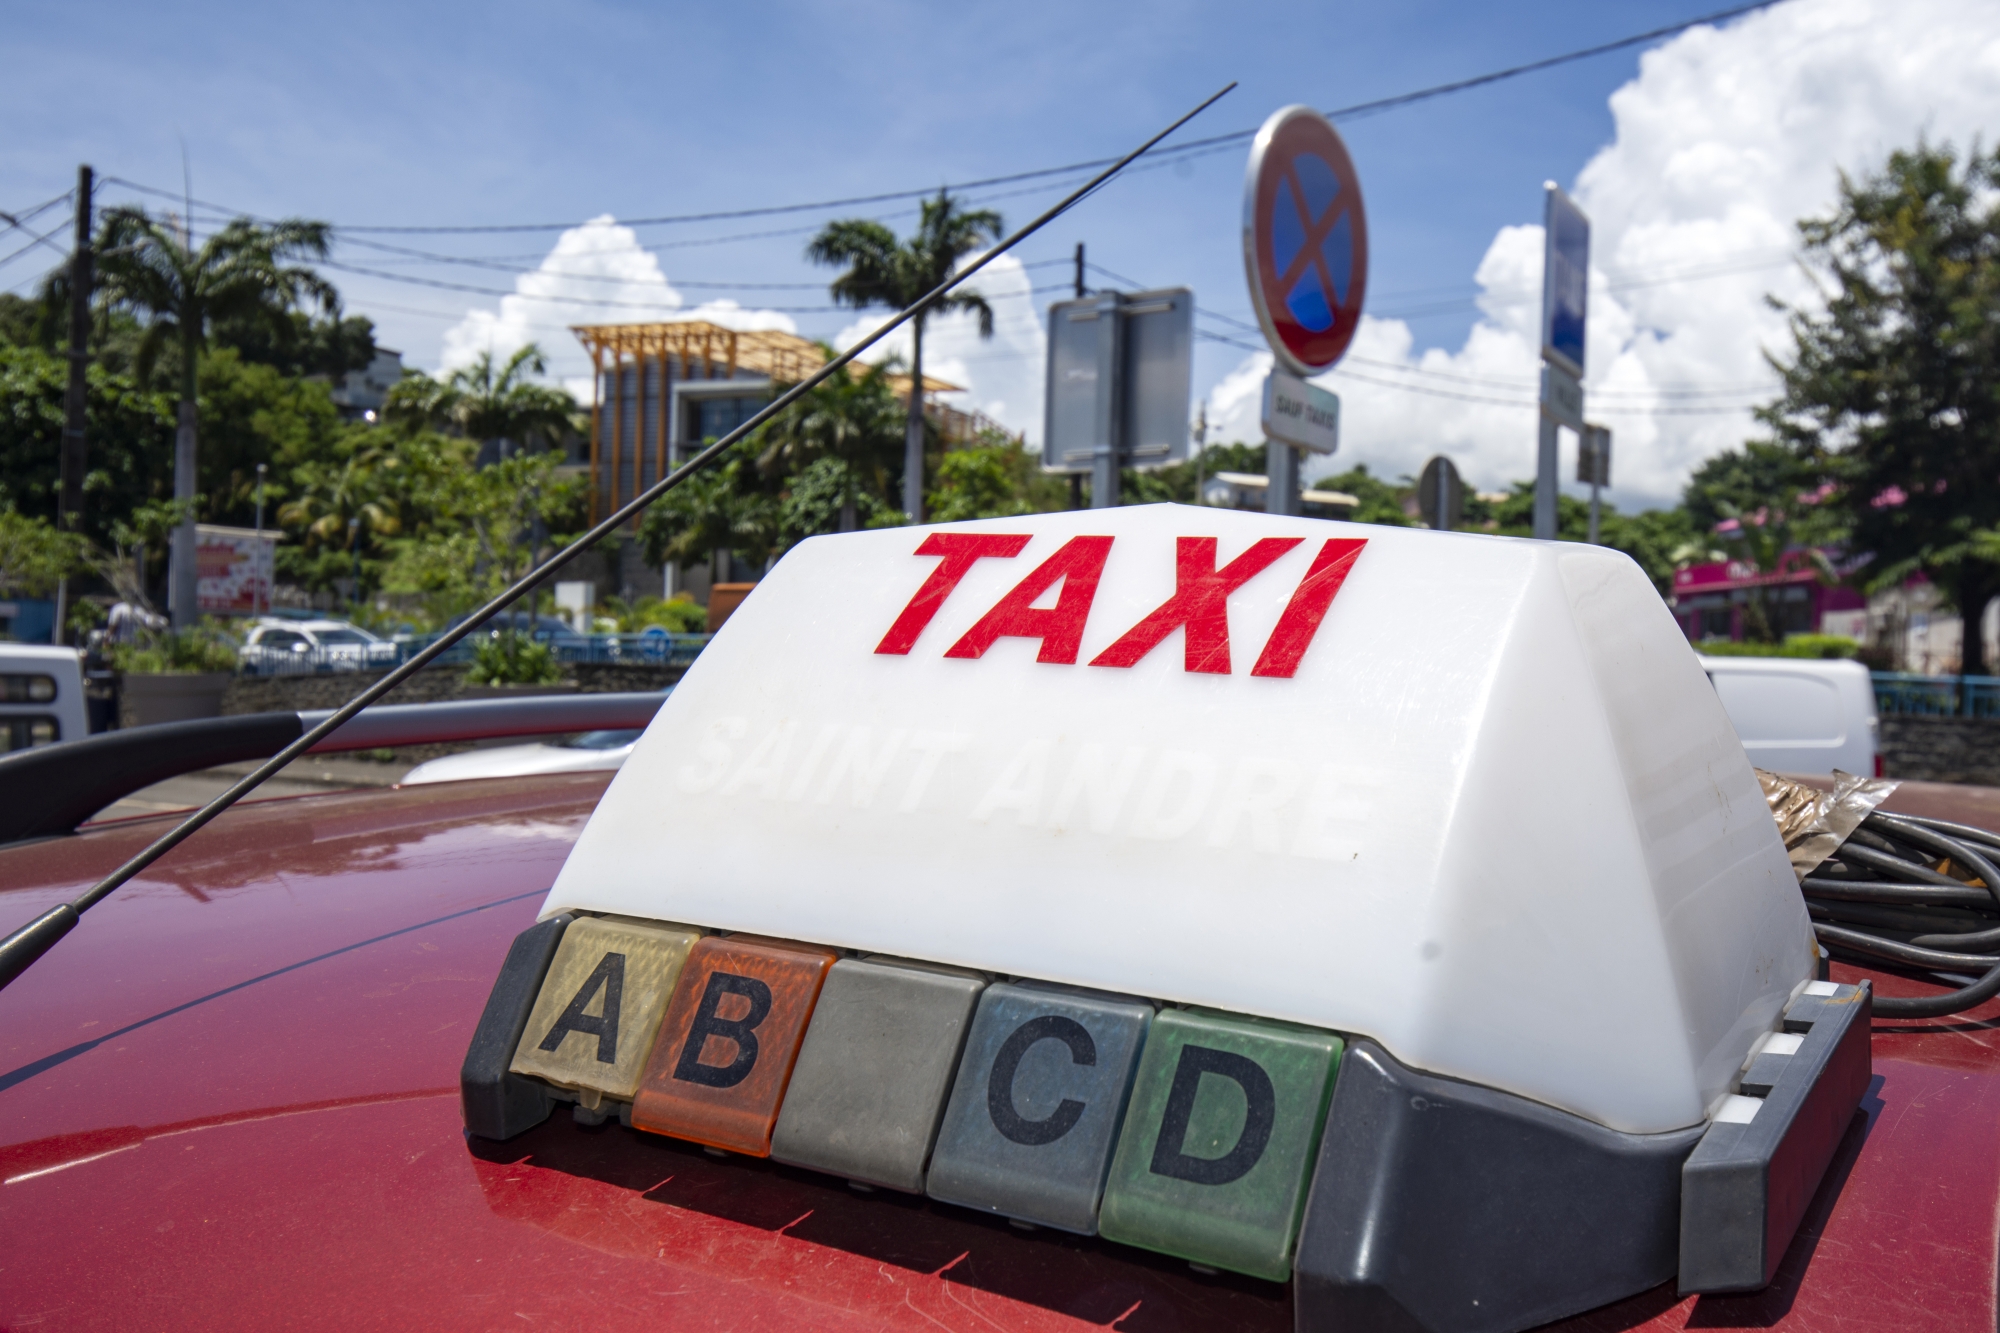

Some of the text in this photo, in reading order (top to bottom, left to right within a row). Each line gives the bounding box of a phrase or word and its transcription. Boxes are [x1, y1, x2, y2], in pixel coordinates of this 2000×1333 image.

[874, 532, 1369, 678] TAXI
[676, 716, 1390, 861] SAINT ANDRE
[538, 951, 1275, 1186] A B C D
